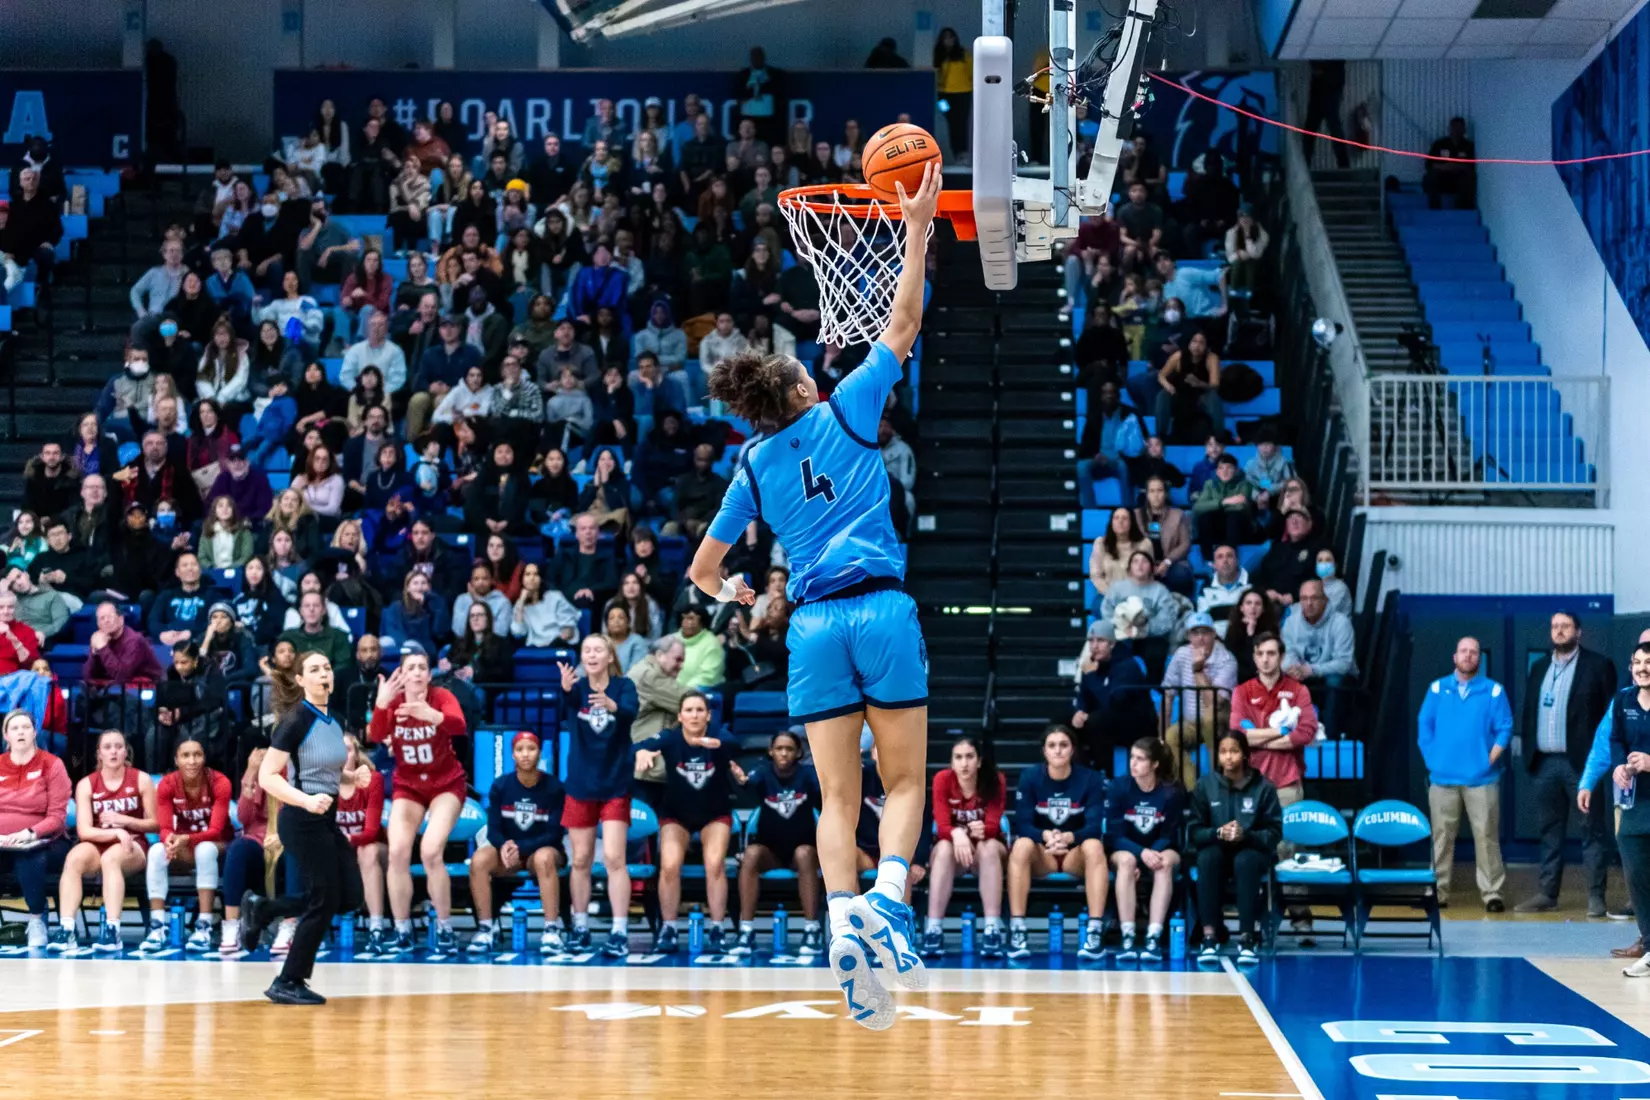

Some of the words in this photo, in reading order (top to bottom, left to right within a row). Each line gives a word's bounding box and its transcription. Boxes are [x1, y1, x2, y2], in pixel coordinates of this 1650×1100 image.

[885, 138, 927, 160] ELITE
[800, 457, 837, 504] 4
[395, 725, 436, 741] PENN
[402, 743, 434, 765] 20
[93, 796, 138, 814] PENN
[335, 810, 365, 823] ENN
[1283, 811, 1337, 826] COLUMBIA
[1365, 811, 1419, 826] COLUMBIA
